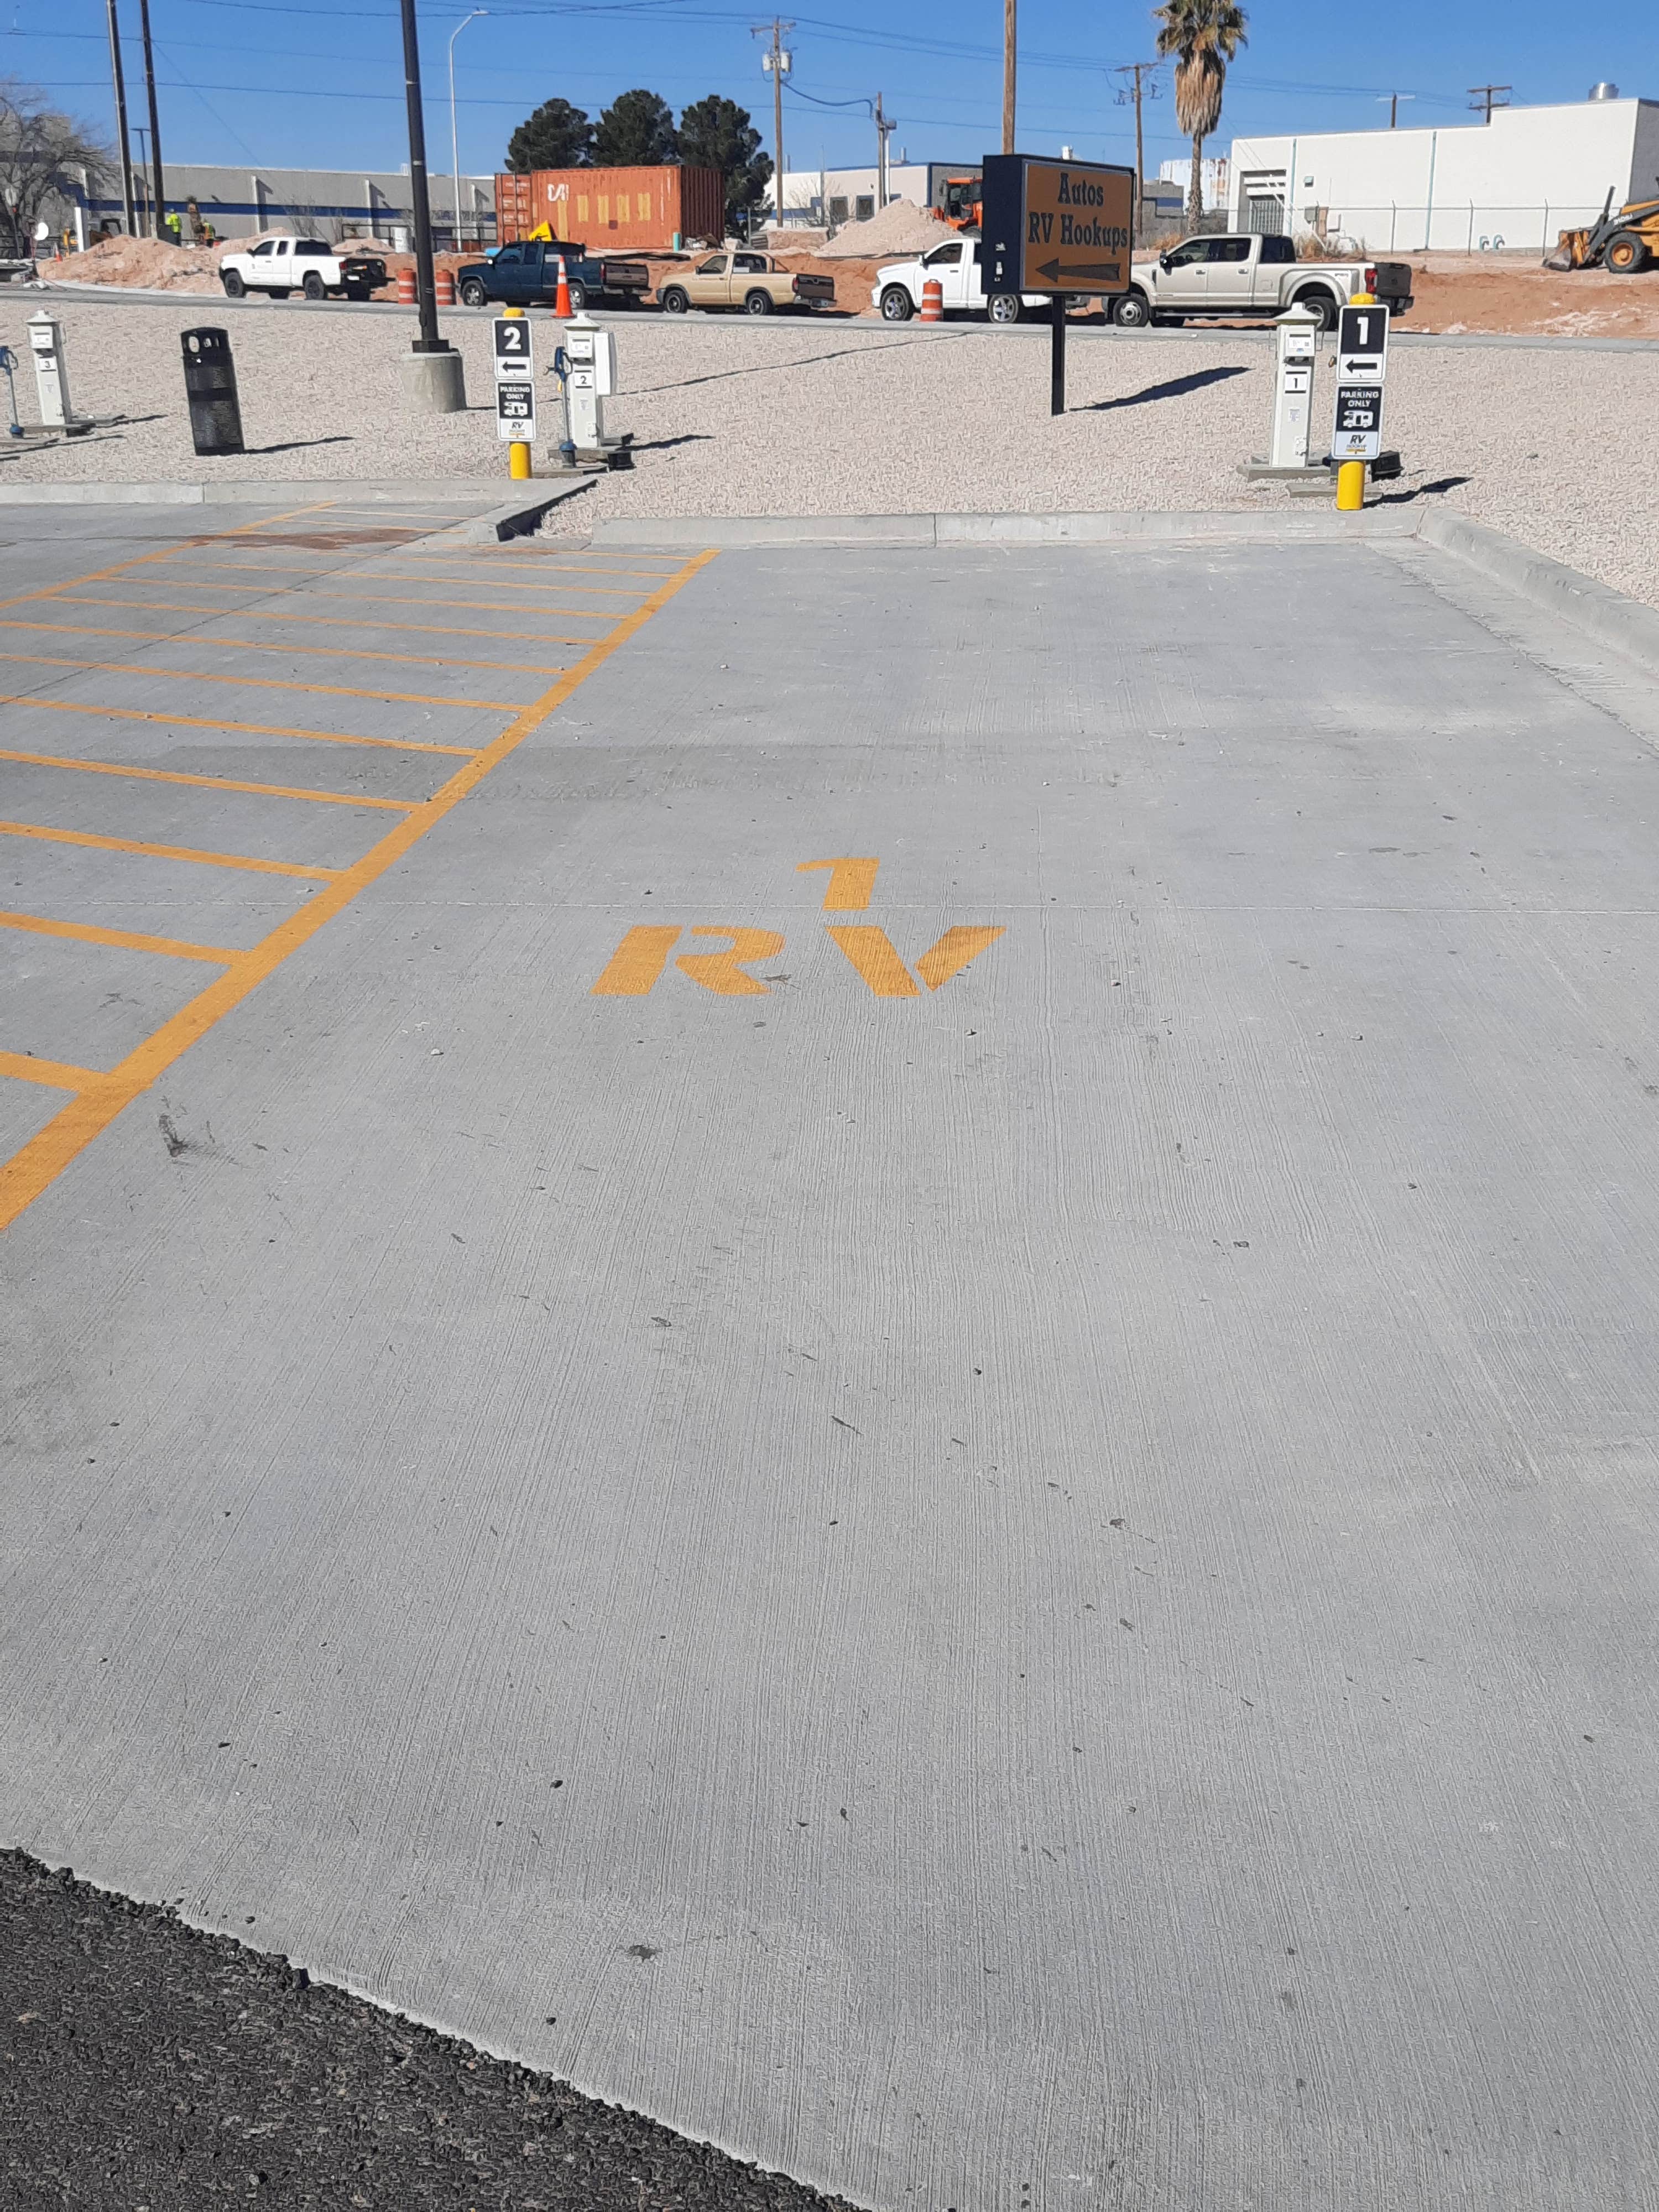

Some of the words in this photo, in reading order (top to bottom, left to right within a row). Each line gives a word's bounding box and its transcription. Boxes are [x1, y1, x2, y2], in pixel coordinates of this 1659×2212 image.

[1058, 173, 1104, 207] Autos
[1028, 212, 1054, 244] RV
[1060, 214, 1128, 255] Hookups
[504, 327, 521, 350] 2
[1357, 316, 1369, 345] 1
[580, 375, 587, 384] 2
[1293, 378, 1298, 389] 1
[1340, 390, 1380, 399] PARKING
[1350, 434, 1367, 444] RV
[795, 857, 880, 911] 1
[589, 925, 1007, 997] RV
